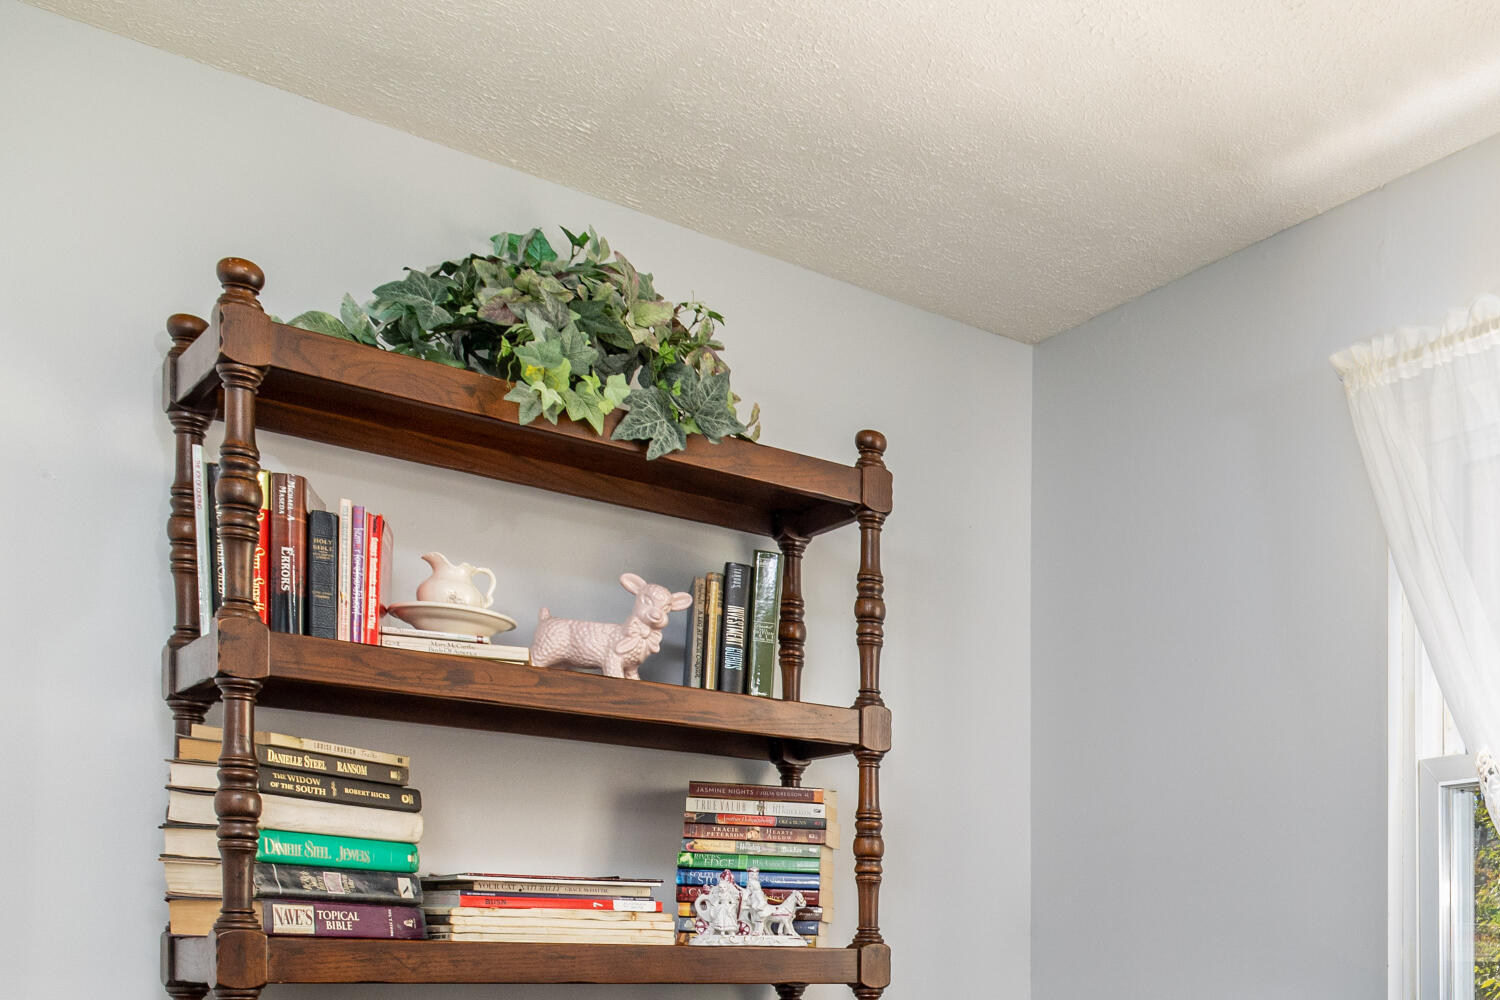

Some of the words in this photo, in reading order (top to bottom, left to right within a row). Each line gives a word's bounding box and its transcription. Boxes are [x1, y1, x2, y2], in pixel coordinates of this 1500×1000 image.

[278, 486, 286, 514] MASEDA
[287, 480, 296, 511] MICHAEL
[281, 546, 294, 592] ERRORS
[726, 605, 744, 648] INVESTMENT
[725, 646, 743, 670] GURUS
[267, 749, 303, 767] DANIELLE
[304, 754, 327, 770] STEEL
[336, 761, 368, 776] RANSOM
[272, 772, 286, 780] THE
[286, 772, 321, 786] WIDOW
[280, 782, 294, 790] THE
[296, 784, 326, 796] SOUTH
[696, 786, 726, 794] JASMINE
[344, 787, 370, 796] ROBERT
[370, 790, 391, 800] HICKS
[264, 836, 304, 858] DANIELLE
[304, 840, 332, 860] STEEL
[336, 845, 371, 864] JEWELS
[478, 882, 497, 890] YOUR
[499, 882, 516, 891] CAT
[274, 906, 313, 927] NAVE'S
[316, 910, 360, 921] TOPICAL
[326, 920, 353, 931] BIBLE
